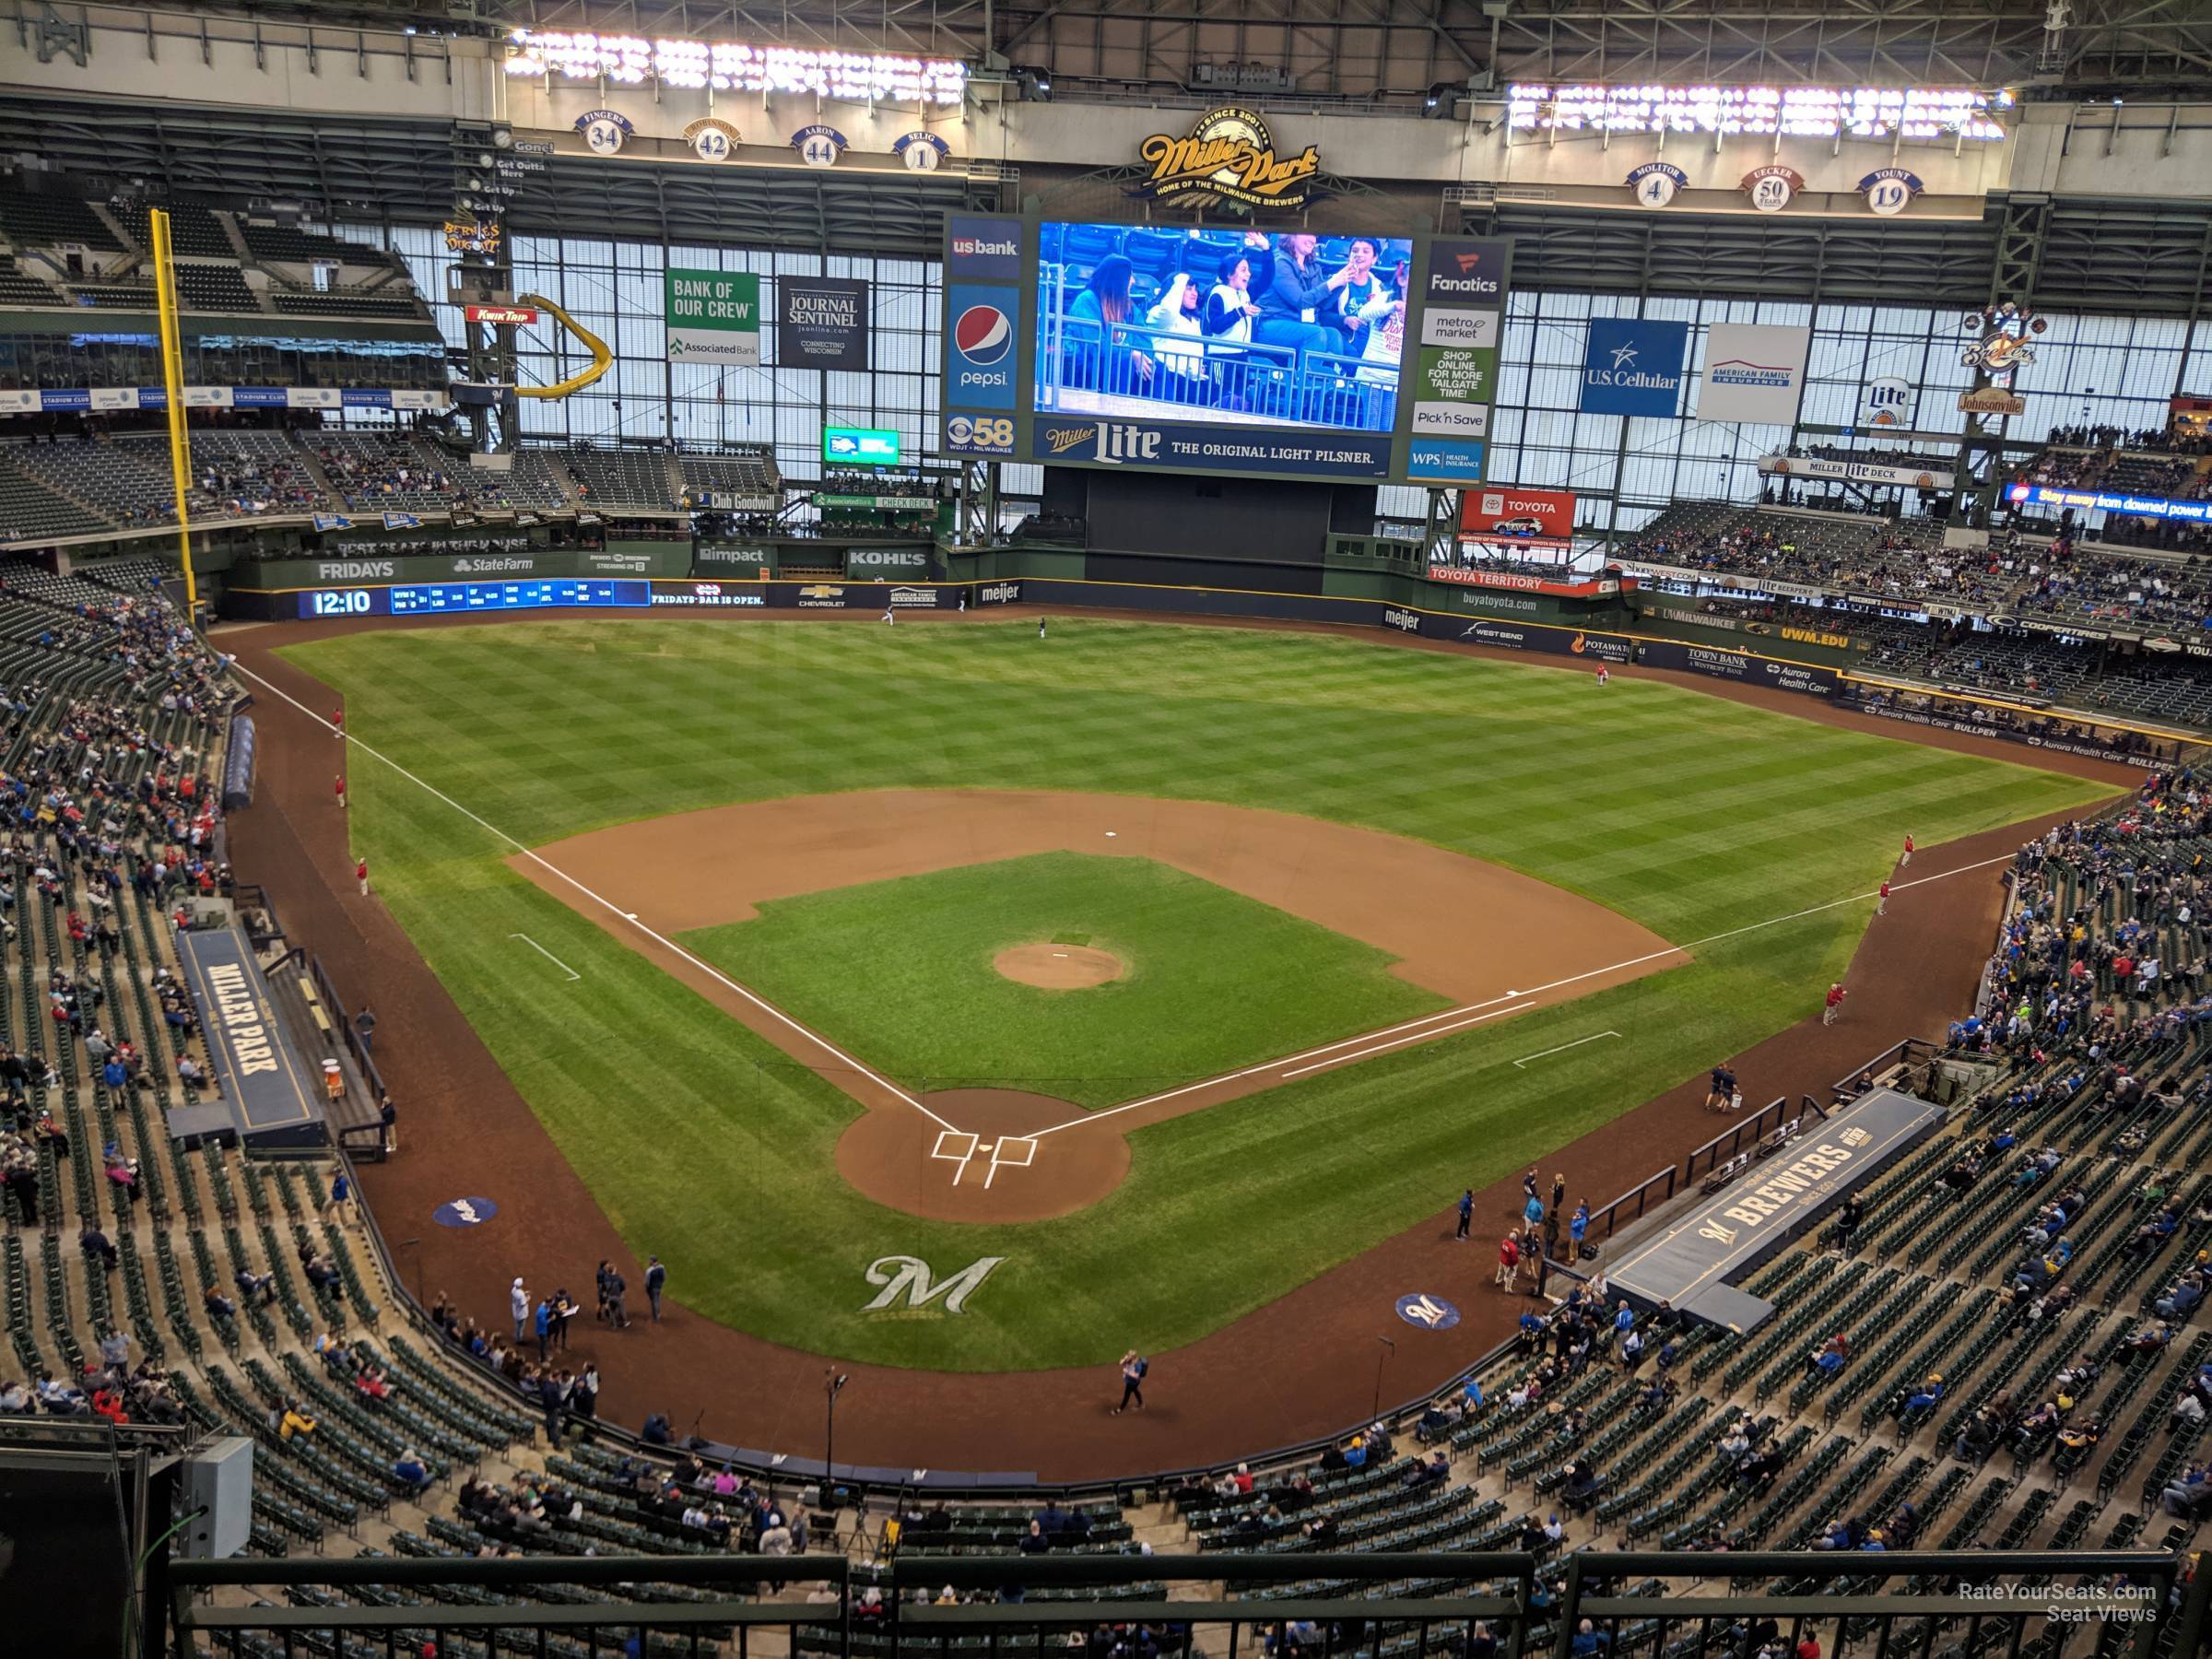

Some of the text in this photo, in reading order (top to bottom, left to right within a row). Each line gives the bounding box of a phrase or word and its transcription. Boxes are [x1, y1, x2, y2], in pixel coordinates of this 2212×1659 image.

[583, 111, 625, 125] FINGERS
[1205, 109, 1260, 128] SINCE 2001
[691, 119, 734, 134] ROBINSON
[805, 126, 835, 137] AARON
[592, 126, 618, 148] 34
[699, 135, 726, 155] 42
[908, 133, 935, 143] SELIG
[515, 141, 554, 153] Gone!
[806, 142, 833, 162] 44
[497, 160, 545, 171] Get Outta
[916, 149, 928, 169] 1
[1143, 135, 1254, 185] Miller
[500, 170, 524, 178] Here
[1228, 144, 1319, 194] Park
[1636, 163, 1680, 178] MOLITOR
[1754, 167, 1793, 179] UECKER
[1874, 169, 1911, 180] YOUNT
[501, 187, 514, 196] Up
[1157, 182, 1180, 195] HOME
[1214, 183, 1262, 205] MILWAUKEE
[1264, 194, 1304, 206] BREWERS
[1648, 181, 1659, 199] 4
[1760, 181, 1783, 198] 50
[1875, 185, 1902, 206] 19
[474, 203, 505, 213] Get Up
[674, 280, 734, 299] BANK OF
[1431, 274, 1498, 292] Fanatics
[675, 299, 703, 316] OUR
[789, 296, 858, 313] JOURNAL
[789, 311, 857, 327] SENTINEL
[1437, 317, 1473, 328] metro
[798, 325, 849, 335] jsonline.com
[1435, 328, 1477, 339] market
[685, 342, 757, 355] Associated Bank
[801, 340, 845, 349] CONNECTING
[804, 347, 842, 356] WISCONSIN
[1442, 351, 1473, 360] SHOP
[1961, 343, 2037, 367] Brewers
[1437, 360, 1476, 371] ONLINE
[960, 371, 1008, 387] pepsi
[1429, 369, 1482, 381] FOR MORE
[1587, 370, 1678, 389] U.S. Cellular
[1713, 369, 1792, 380] AMERICAN FAMILY
[1717, 377, 1784, 386] INSURANCE
[1431, 378, 1478, 390] TAILGATE
[1440, 389, 1467, 398] TIME!
[1869, 386, 1906, 408] Lite
[1959, 395, 2021, 413] Johnsonville
[1454, 415, 1483, 426] Save
[972, 418, 1014, 447] 58
[1046, 422, 1161, 464] Miller Lite
[1171, 441, 1374, 465] THE ORIGINAL LIGHT PILSNER.
[1413, 453, 1441, 465] WPS
[1809, 463, 1896, 479] MILLER Lite DECK
[712, 494, 775, 512] Club Goodwill
[882, 498, 929, 508] CHECK DECK
[1508, 500, 1556, 514] TOYOTA
[2039, 489, 2065, 504] Stay
[2066, 493, 2097, 509] away
[2098, 494, 2122, 509] from
[2123, 498, 2168, 514] downed
[2168, 505, 2205, 517] power
[712, 547, 764, 563] impact
[850, 552, 926, 566] KOHL'S
[319, 561, 394, 579] FRIDAYS
[1432, 568, 1543, 590] TOYOTA TERRITORY
[699, 595, 720, 605] BAR
[721, 596, 732, 605] IS
[733, 596, 764, 605] OPEN.
[982, 582, 1019, 604] meijer
[313, 590, 371, 615] 12:10
[1464, 592, 1536, 612] buyatoyota.com
[1385, 609, 1419, 630] meijer
[1477, 629, 1524, 641] WEST BEND
[1782, 627, 1849, 648] UWM.EDU
[1688, 648, 1748, 666] TOWN BANK
[1694, 661, 1744, 676] WINTRUST BANK
[1782, 667, 1811, 679] Aurora
[1778, 677, 1829, 694] Health Care
[1877, 708, 1997, 737] Aurora Health Care BULLPEN
[2042, 739, 2071, 752] Aurora
[2072, 746, 2101, 758] Health
[2102, 751, 2124, 762] Care
[207, 963, 259, 1027] MILLER
[229, 1024, 278, 1077] PARK
[1724, 1144, 1853, 1227] BREWERS
